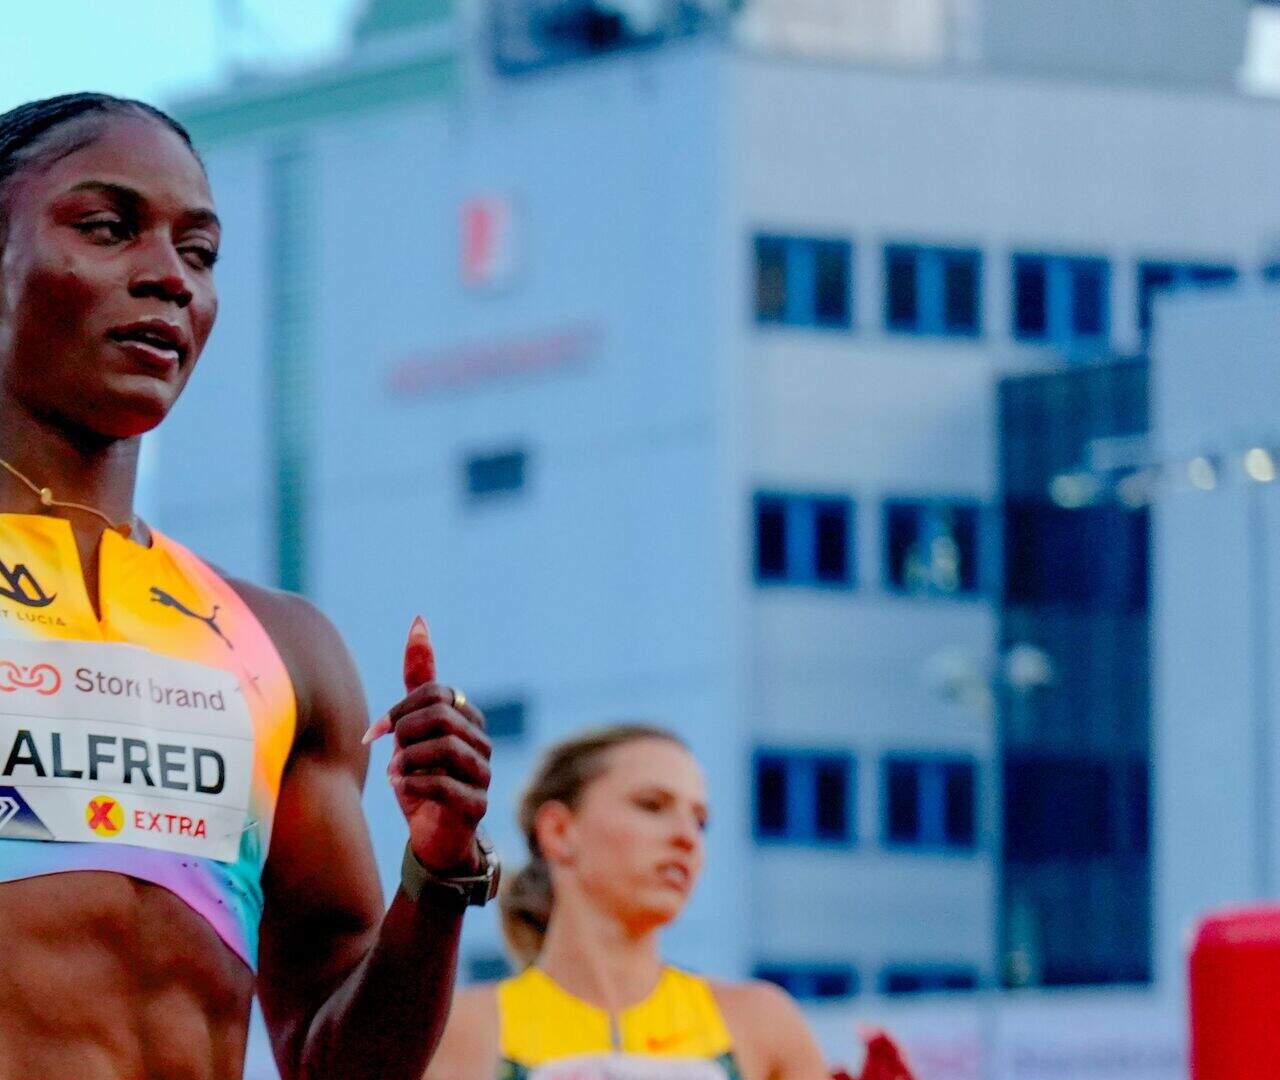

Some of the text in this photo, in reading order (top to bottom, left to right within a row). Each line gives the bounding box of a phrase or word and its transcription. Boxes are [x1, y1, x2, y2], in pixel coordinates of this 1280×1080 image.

[16, 612, 66, 626] LUCIA
[1, 729, 226, 795] ALFRED
[134, 810, 207, 839] EXTRA
